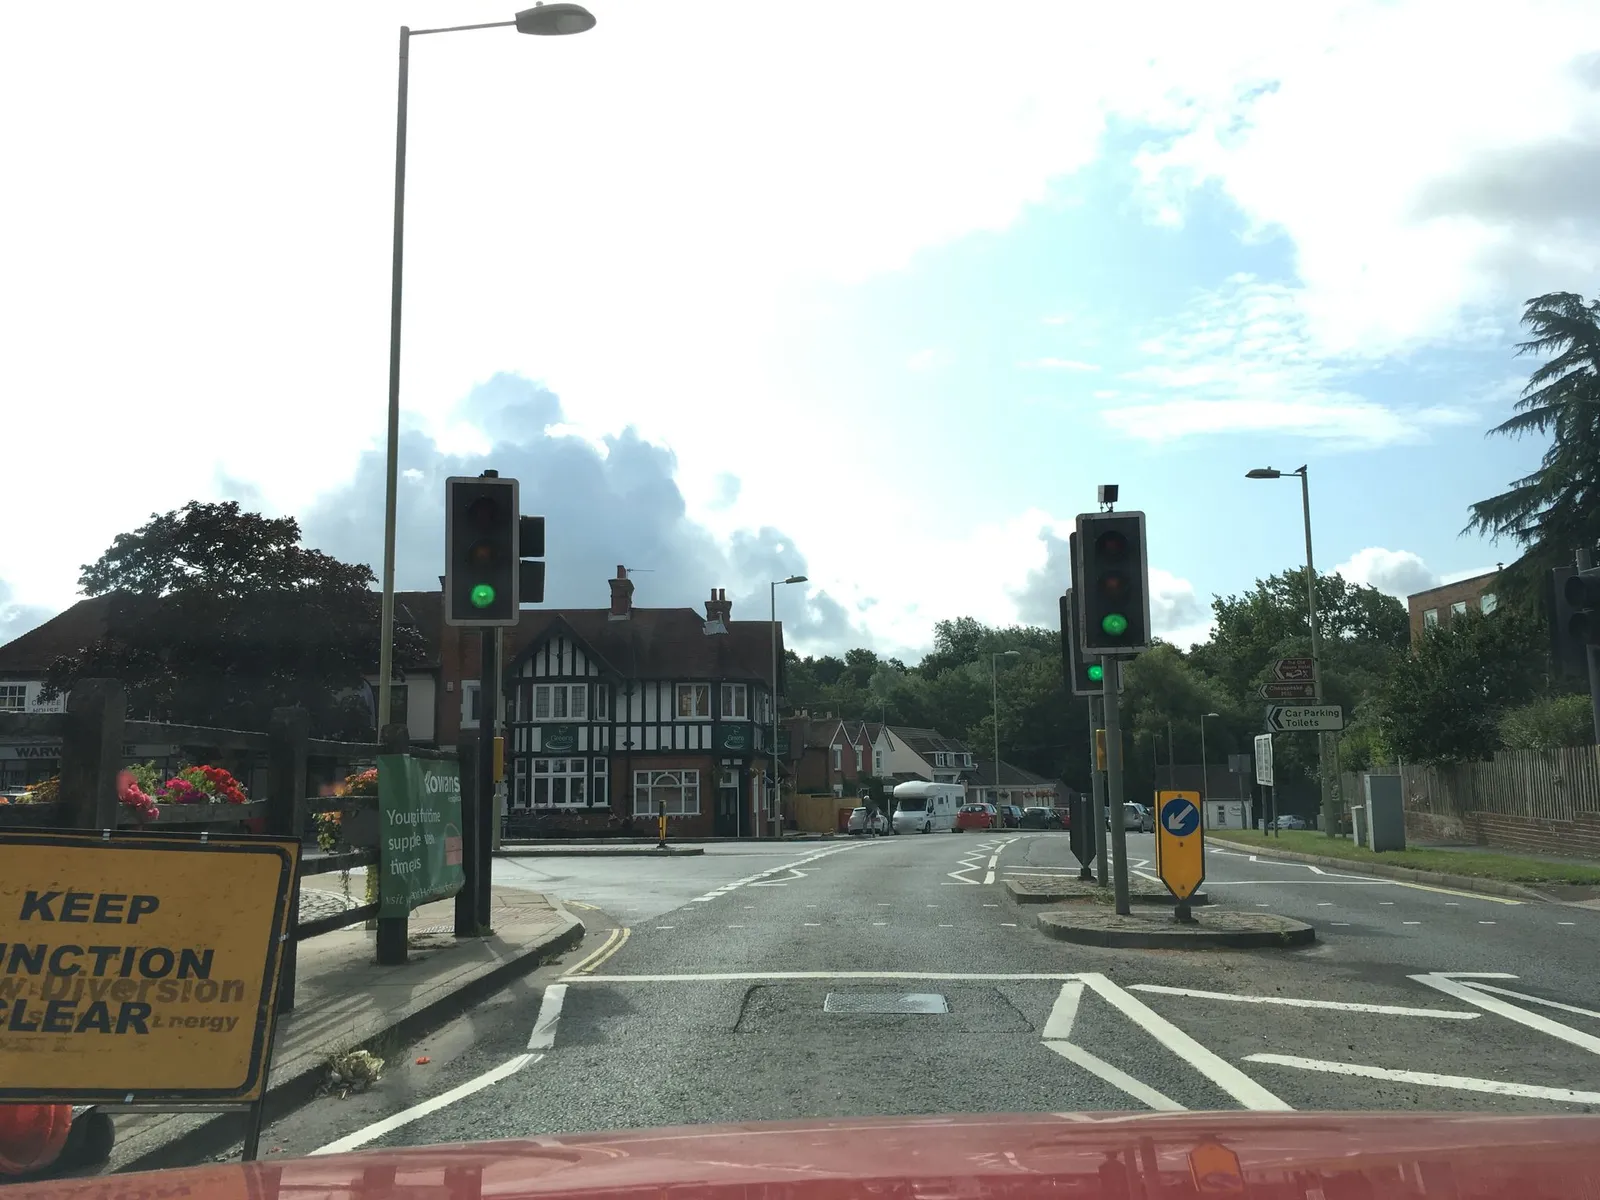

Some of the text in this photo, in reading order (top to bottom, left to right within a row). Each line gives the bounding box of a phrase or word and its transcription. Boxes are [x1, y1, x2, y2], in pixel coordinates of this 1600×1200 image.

[1285, 709, 1340, 718] Car Parking
[1285, 719, 1319, 727] Toilets
[19, 890, 160, 925] KEEP
[0, 943, 215, 980] NCTION
[40, 971, 245, 1004] Diversion
[0, 998, 152, 1035] LEAR
